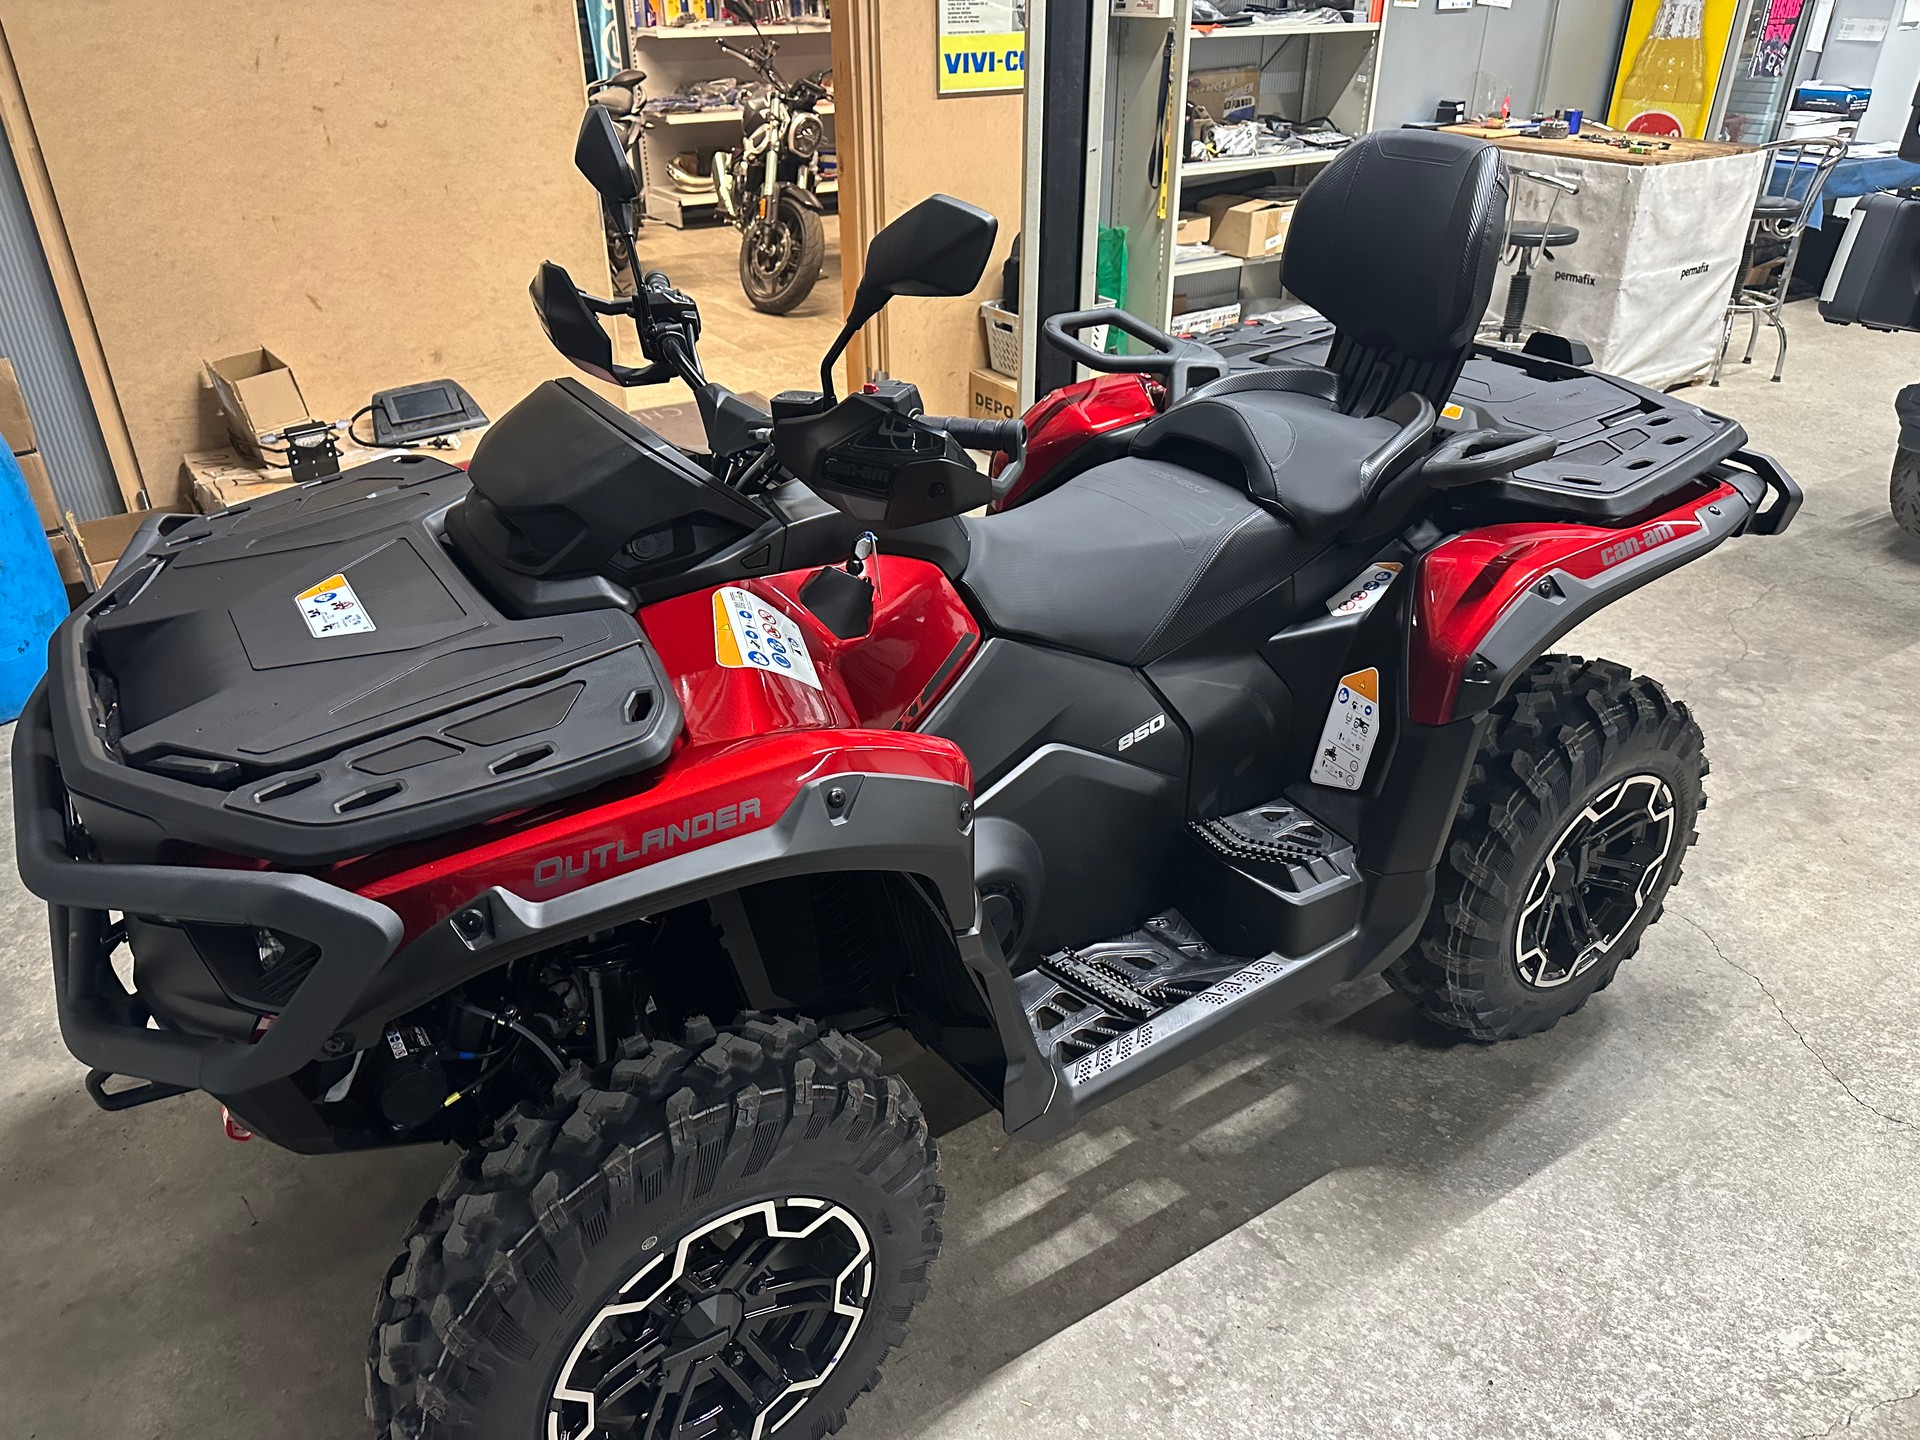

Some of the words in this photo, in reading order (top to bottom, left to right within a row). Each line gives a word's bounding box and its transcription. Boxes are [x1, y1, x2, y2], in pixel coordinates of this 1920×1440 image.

[1554, 270, 1596, 287] permafix
[1680, 262, 1710, 280] permafix
[975, 391, 1014, 419] DEPO
[1600, 523, 1676, 567] can-am
[1118, 714, 1165, 752] 850
[533, 797, 761, 888] OUTLANDER
